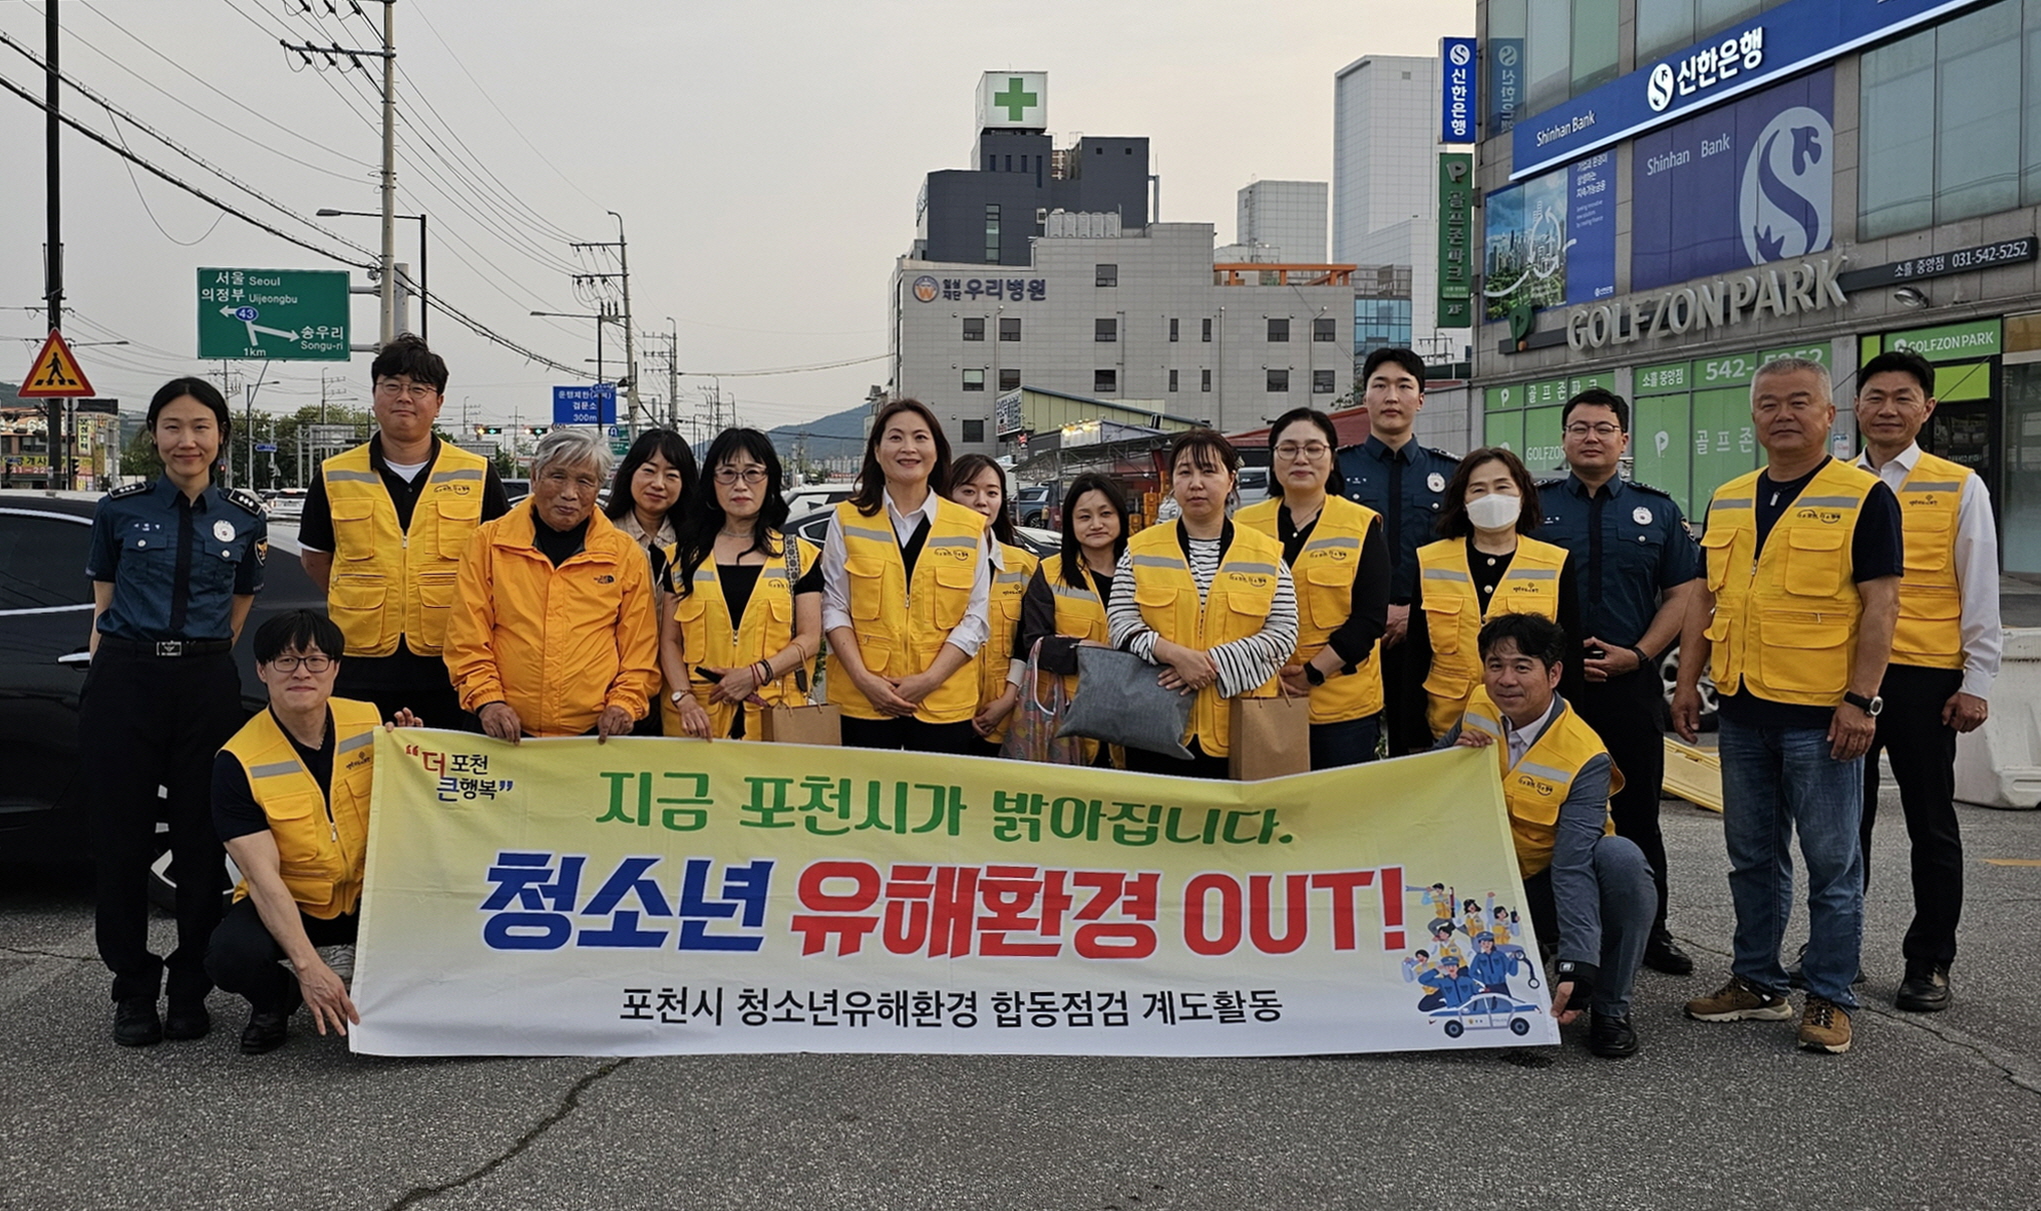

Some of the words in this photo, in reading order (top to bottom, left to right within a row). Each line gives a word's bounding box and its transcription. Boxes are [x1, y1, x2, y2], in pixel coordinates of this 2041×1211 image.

[1677, 26, 1764, 97] 신한은행
[1450, 68, 1468, 136] 신한은행
[1536, 122, 1572, 147] Shinhan
[1572, 110, 1596, 133] Bank
[1647, 150, 1690, 176] Shinhan
[1701, 133, 1730, 158] Bank
[1894, 263, 1913, 278] 소흘
[1916, 255, 1945, 275] 중앙점
[1952, 241, 2028, 268] 031-542-5252
[215, 271, 245, 286] 서울
[249, 277, 281, 286] Seoul
[201, 288, 245, 302] 의정부
[248, 294, 298, 304] Uijeongbu
[964, 279, 1046, 302] 우리병원
[238, 309, 254, 319] 43
[301, 326, 344, 340] 송우리
[244, 348, 266, 357] 1km
[301, 341, 343, 352] Songu-ri
[1659, 368, 1684, 386] 중앙점
[573, 402, 597, 410] 검문소
[573, 414, 597, 422] 300m
[450, 754, 488, 775] 포천
[597, 772, 713, 832] 지금
[740, 776, 966, 836] 포천시가
[993, 791, 1294, 846] 밝아집니다.
[480, 852, 774, 952] 청소년
[791, 862, 1160, 959] 유해환경
[1185, 868, 1405, 955] OUT!
[620, 986, 723, 1026] 포천시
[737, 987, 978, 1028] 청소년유해환경
[990, 990, 1129, 1028] 합동점검
[1142, 990, 1283, 1026] 계도활동
